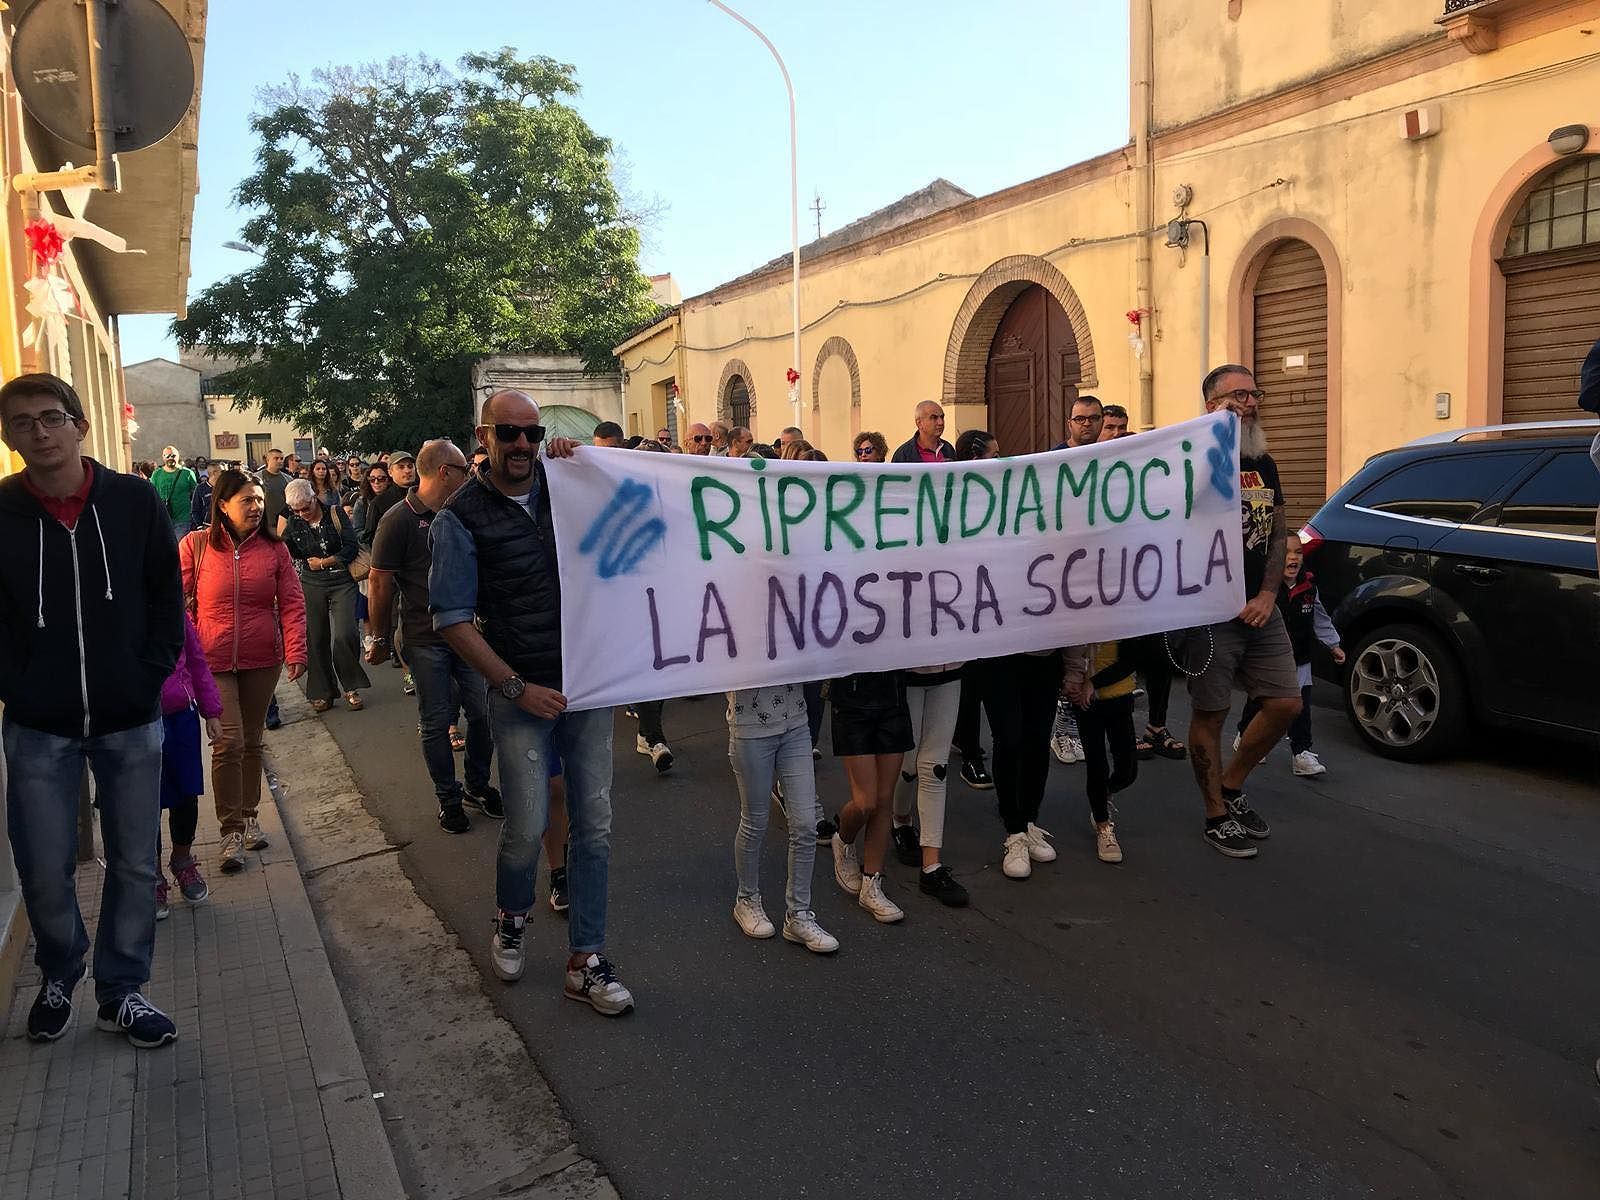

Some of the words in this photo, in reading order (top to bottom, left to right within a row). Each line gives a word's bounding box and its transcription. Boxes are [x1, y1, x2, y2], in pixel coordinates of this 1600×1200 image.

[647, 581, 738, 671] LA
[766, 565, 1004, 661] NOSTRA
[1022, 528, 1233, 617] SCUOLA
